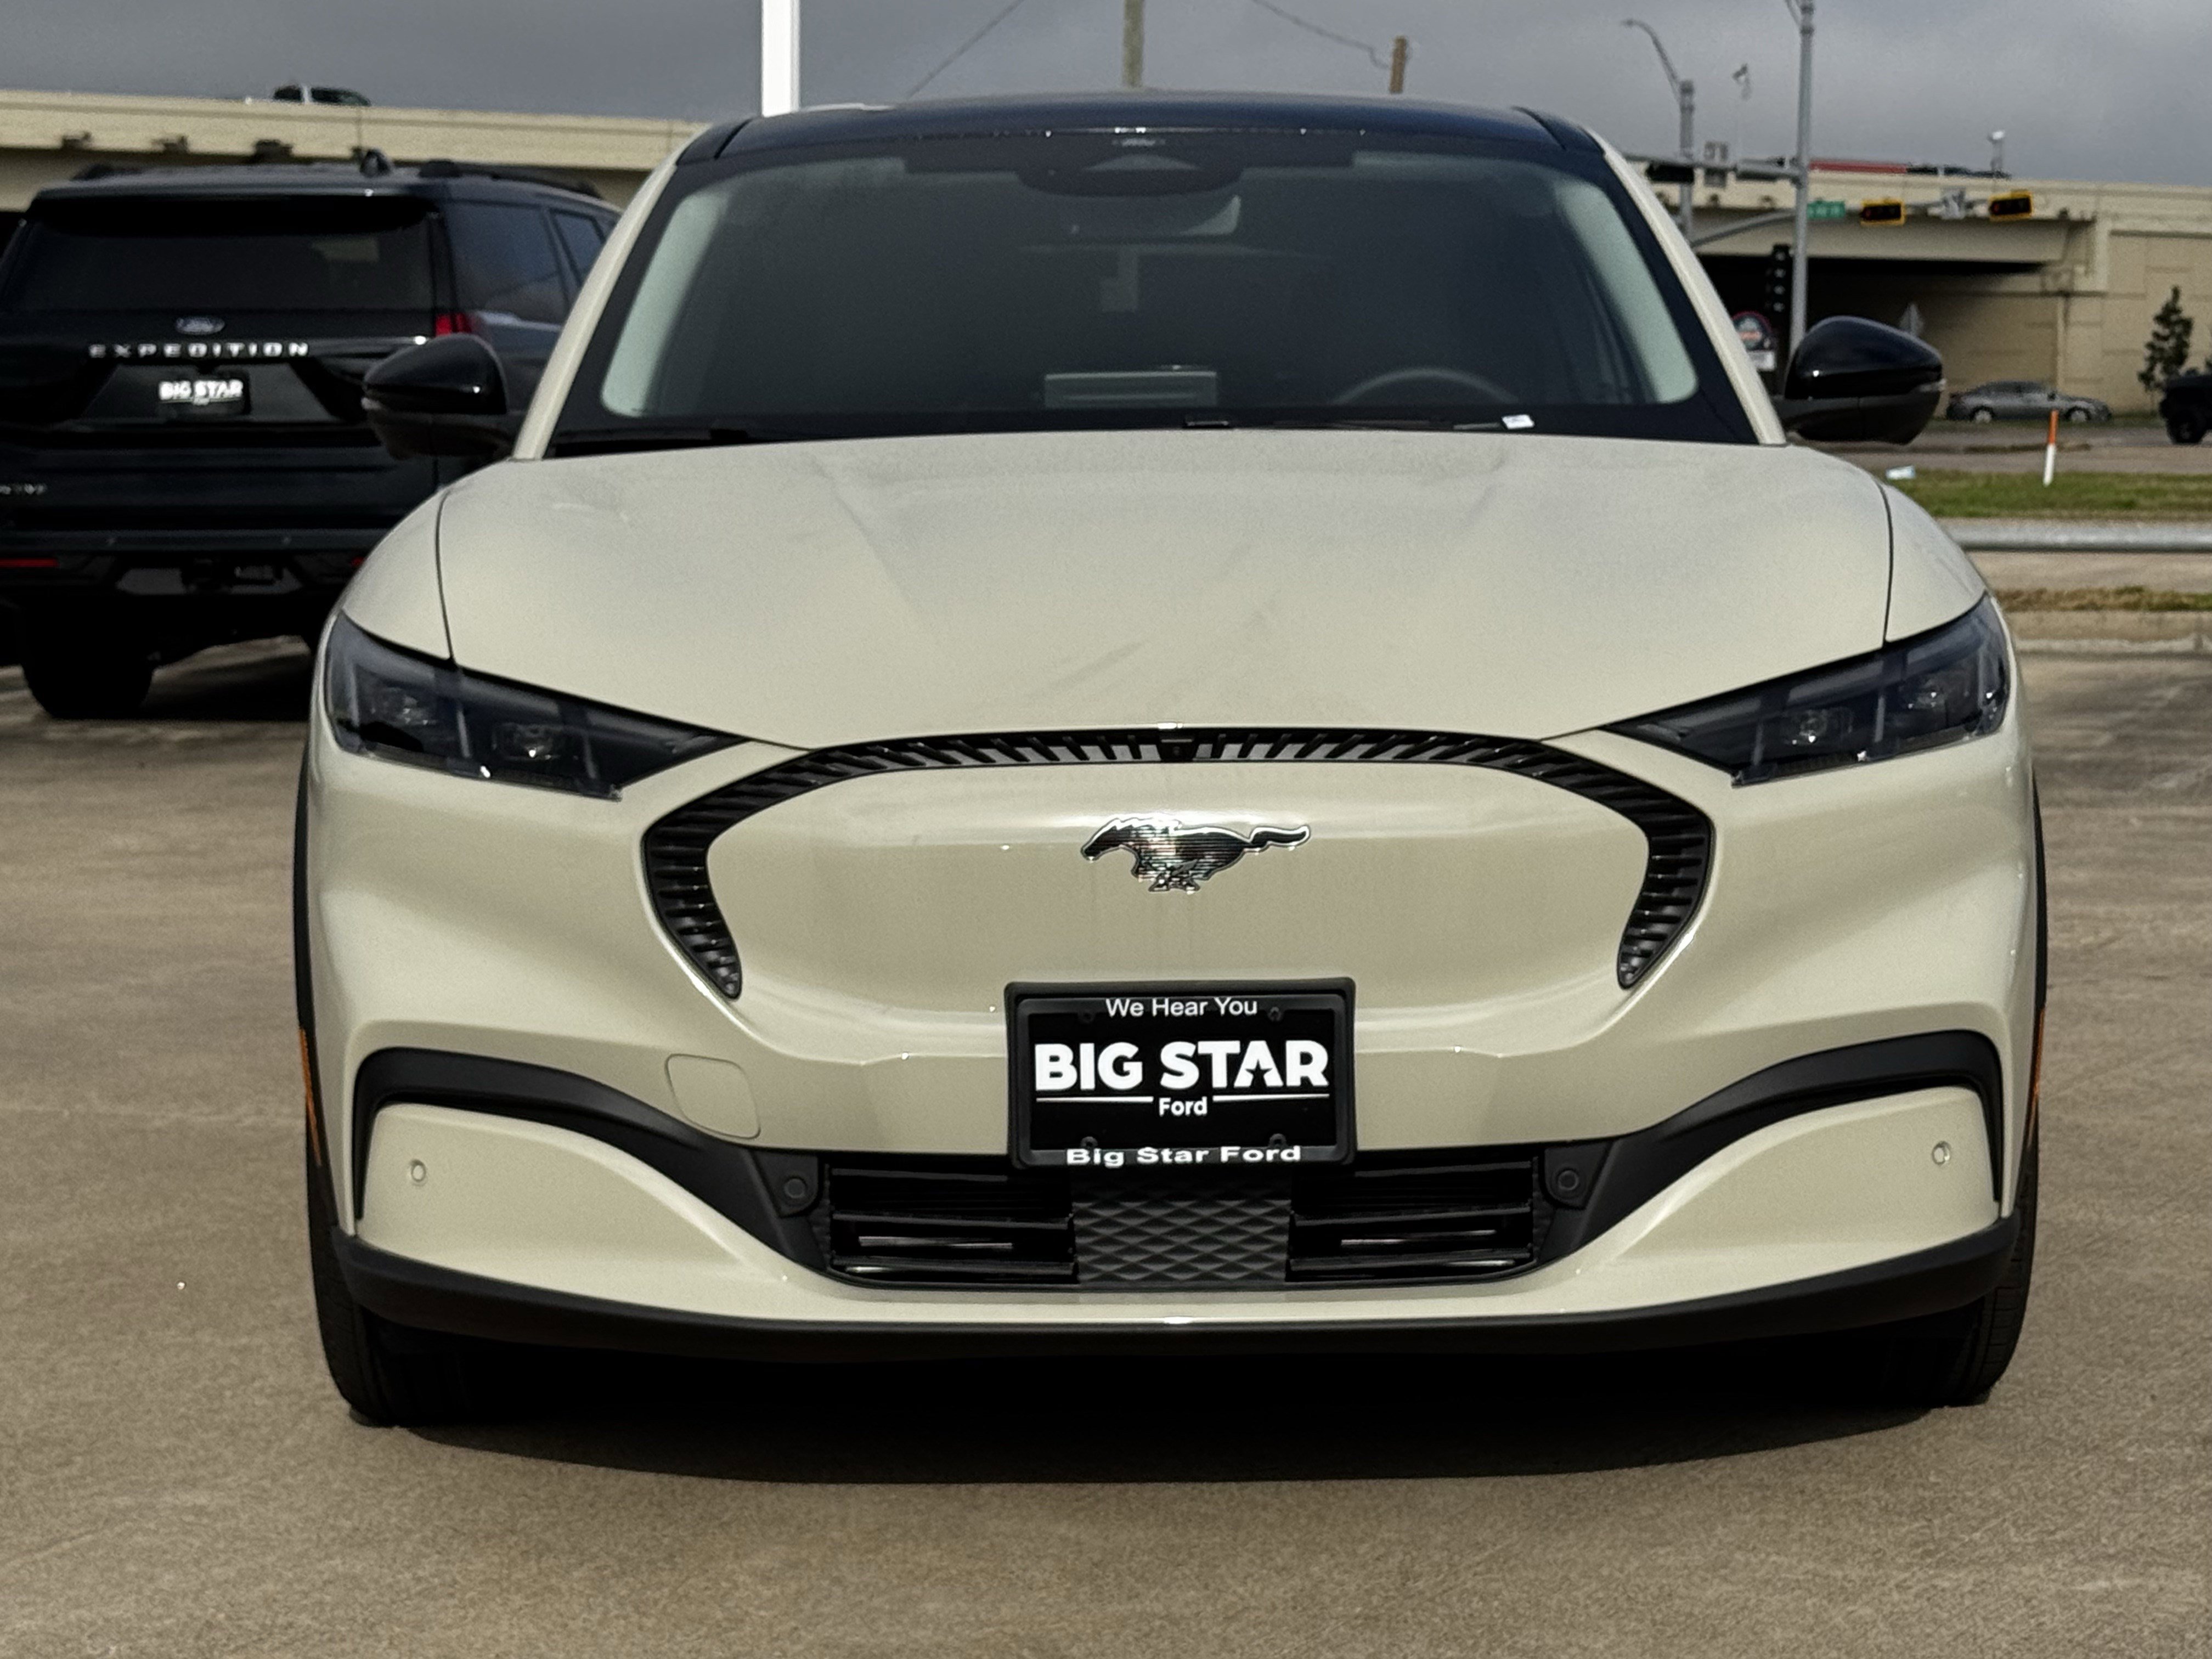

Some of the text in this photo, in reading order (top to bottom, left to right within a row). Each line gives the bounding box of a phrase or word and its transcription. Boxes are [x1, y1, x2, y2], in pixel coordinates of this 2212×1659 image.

[89, 342, 308, 357] EXPEDITION
[159, 379, 244, 400] BIG STAR
[1105, 996, 1257, 1017] We Hear You
[1035, 1040, 1329, 1091] BIG STAR
[1158, 1097, 1208, 1116] Ford
[1066, 1145, 1301, 1168] Big Star Ford
